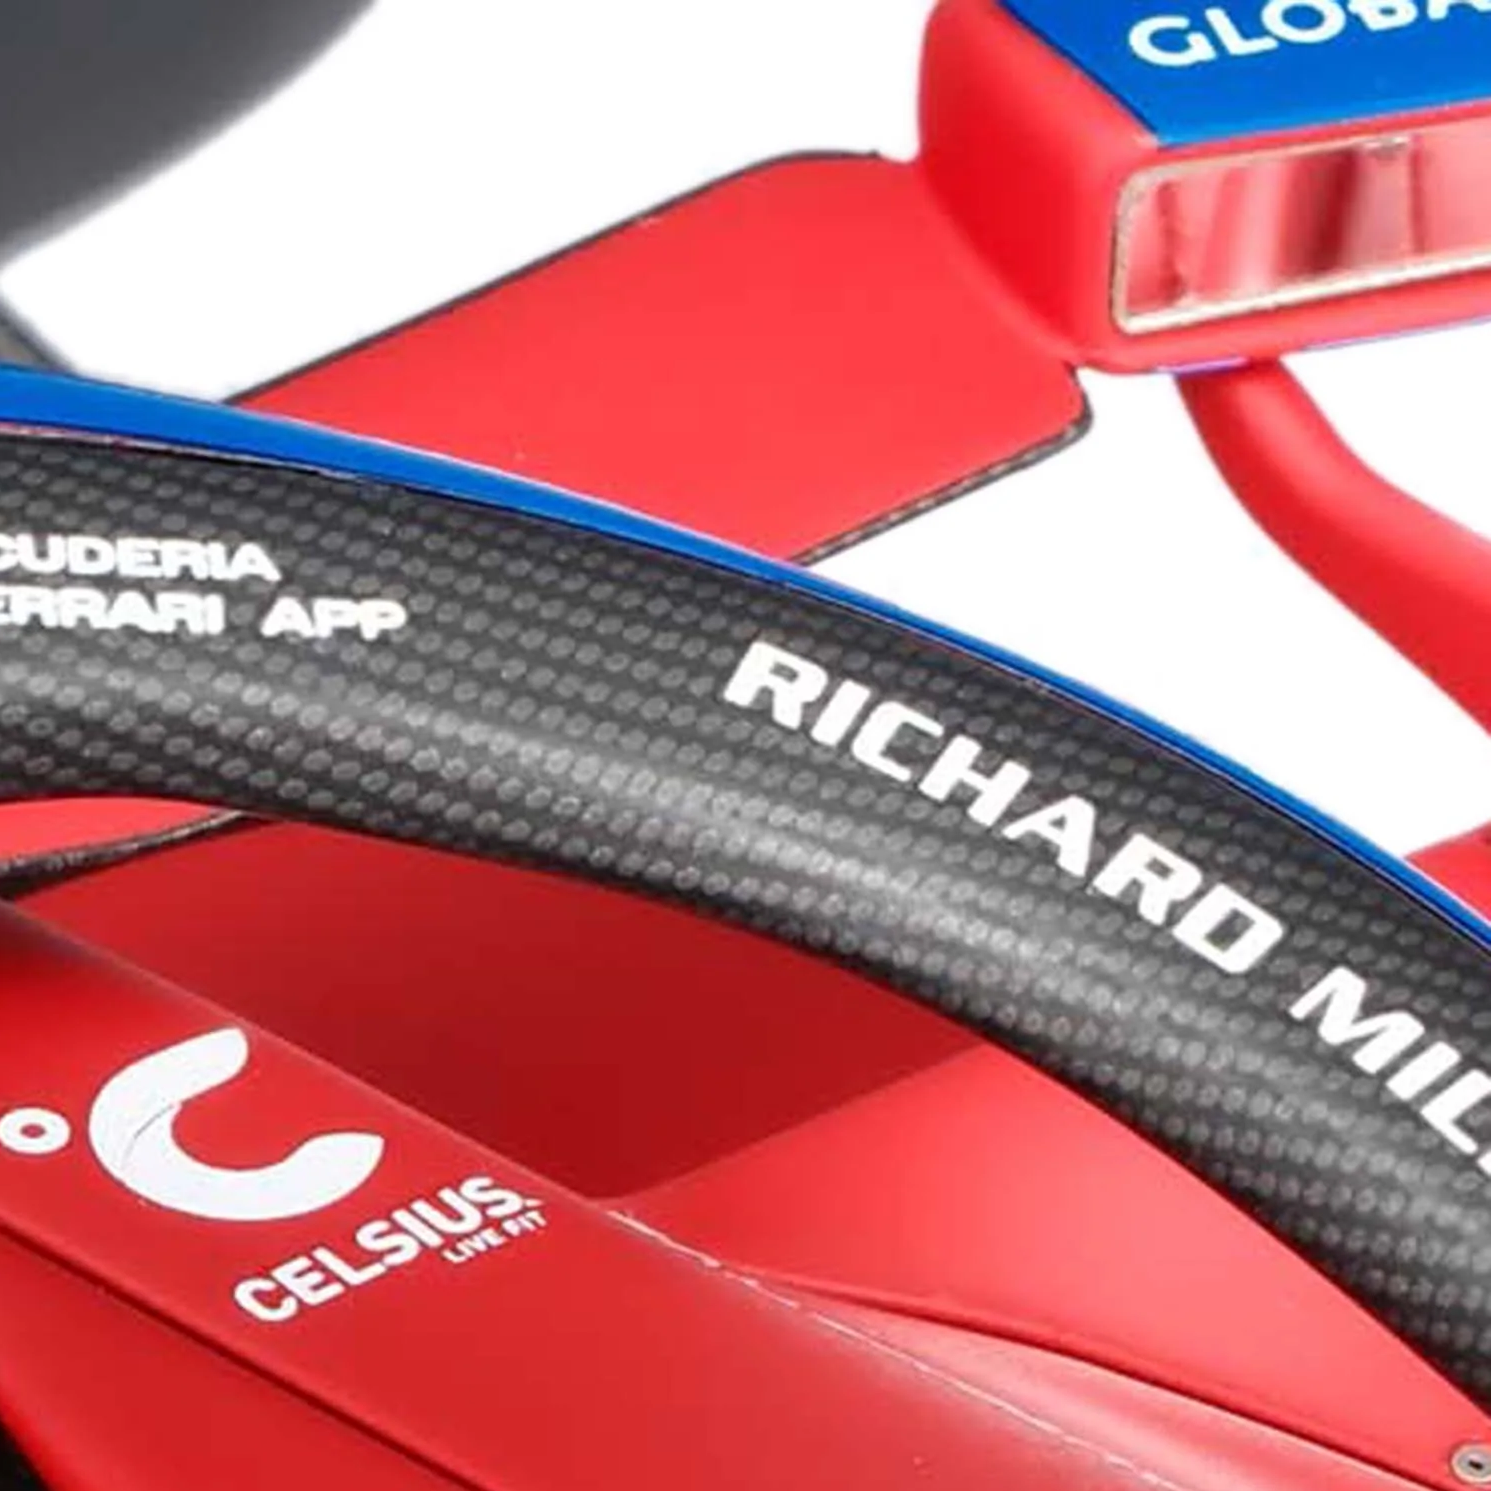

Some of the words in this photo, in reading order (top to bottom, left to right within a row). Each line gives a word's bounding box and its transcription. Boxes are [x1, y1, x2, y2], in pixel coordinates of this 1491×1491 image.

[259, 596, 409, 642] APP
[722, 641, 1285, 974] RICHARD
[1289, 966, 1491, 1177] MIL
[442, 1228, 507, 1263] LIVE
[501, 1210, 547, 1236] FIT
